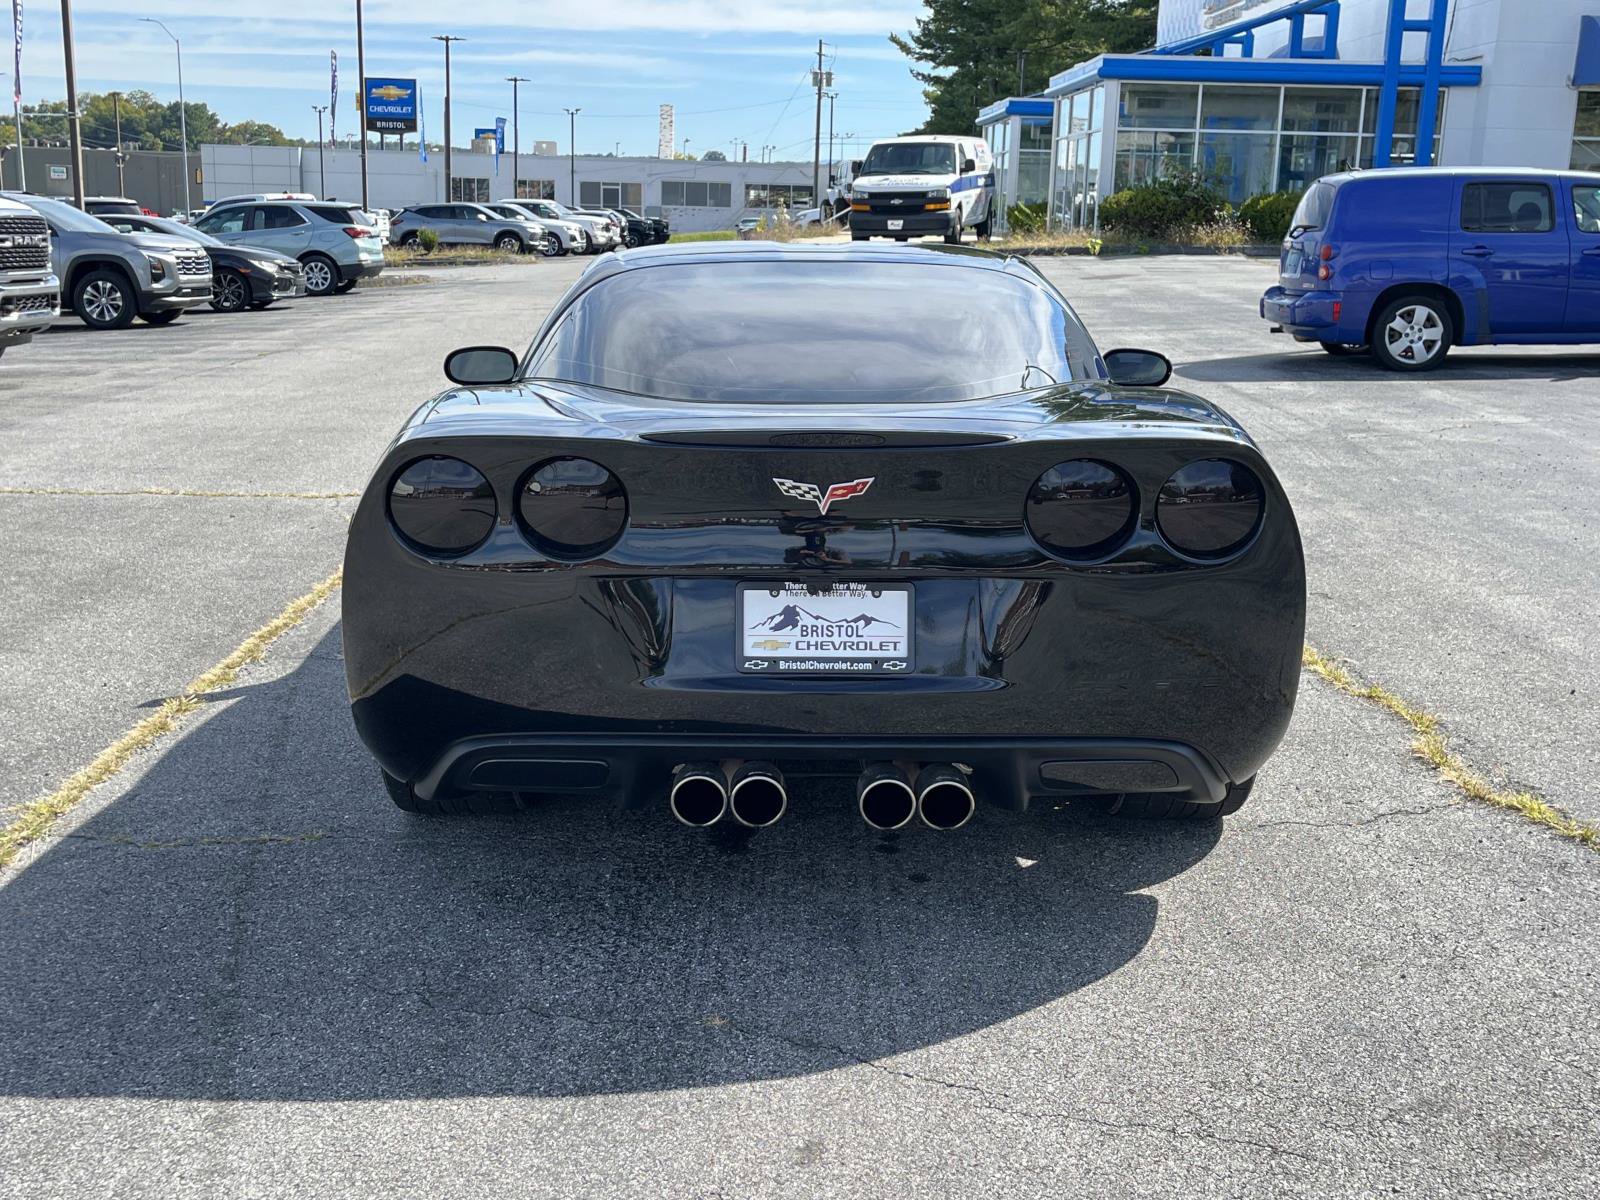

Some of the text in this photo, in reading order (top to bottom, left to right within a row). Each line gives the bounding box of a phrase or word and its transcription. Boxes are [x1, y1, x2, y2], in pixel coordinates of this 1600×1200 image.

[369, 105, 413, 114] CHEVROLET
[376, 121, 406, 129] BRISTOL
[14, 235, 42, 246] RAM
[784, 582, 808, 590] There
[849, 582, 867, 592] Way
[800, 624, 864, 638] BRISTOL
[795, 640, 901, 651] CHEVROLET
[779, 660, 872, 670] BristolChevrolet.com
